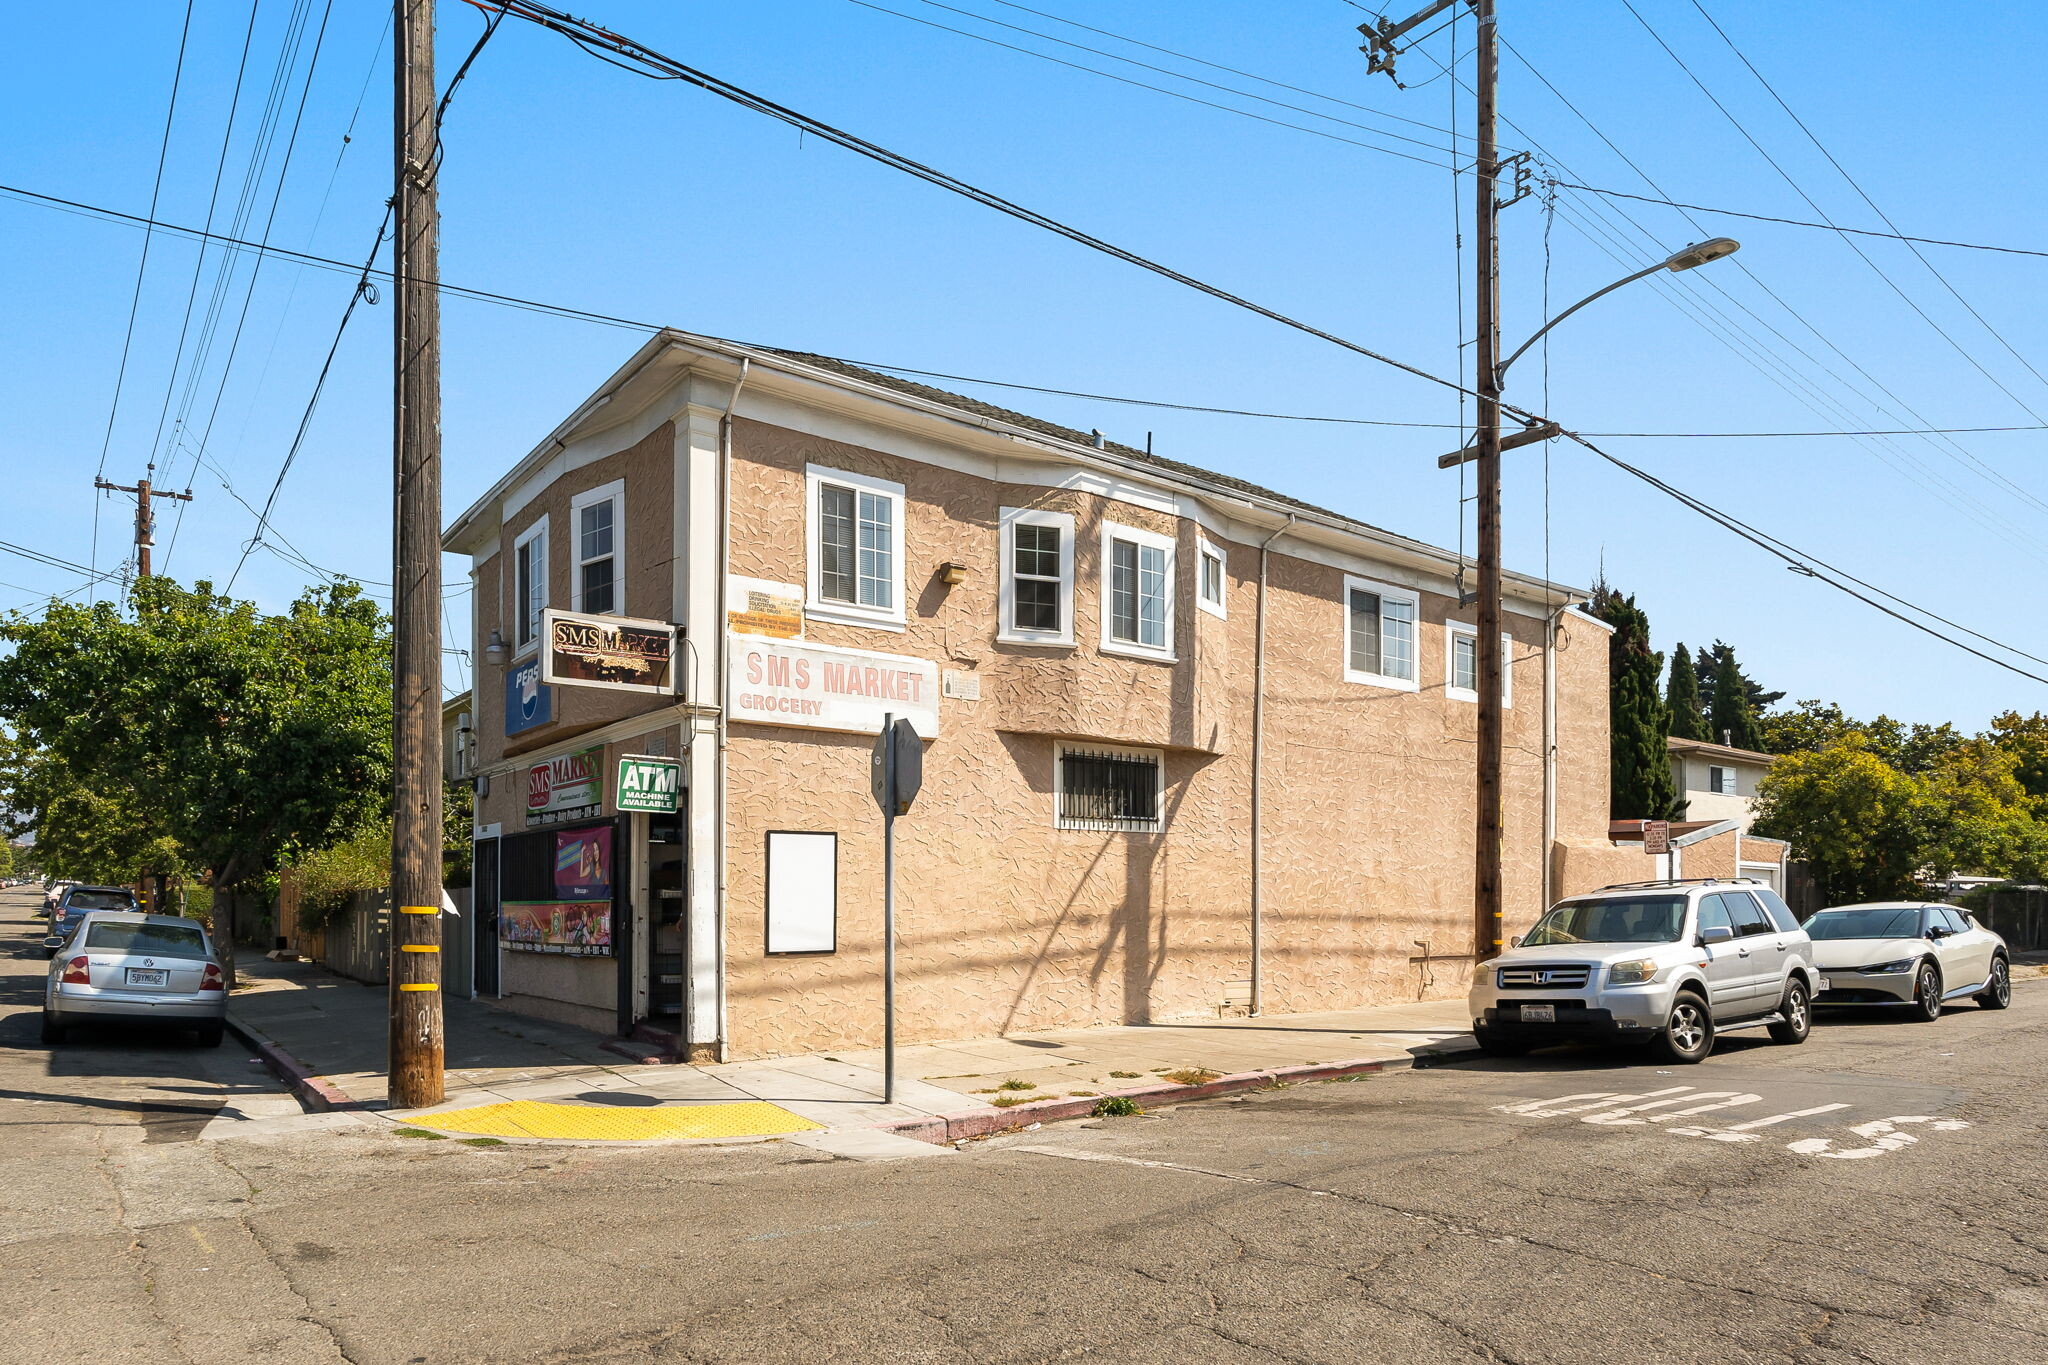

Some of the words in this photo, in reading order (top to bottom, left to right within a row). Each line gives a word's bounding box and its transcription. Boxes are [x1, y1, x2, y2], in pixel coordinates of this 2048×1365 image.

[748, 601, 777, 609] SOLICITATION
[556, 625, 599, 647] SMS
[516, 664, 539, 689] PEPS
[746, 651, 811, 690] SMS
[823, 661, 923, 702] MARKET
[739, 693, 823, 716] GROCERY
[529, 770, 550, 795] SMS
[622, 764, 678, 793] ATM
[622, 798, 673, 808] AVAILABLE
[625, 791, 671, 801] MACHINE
